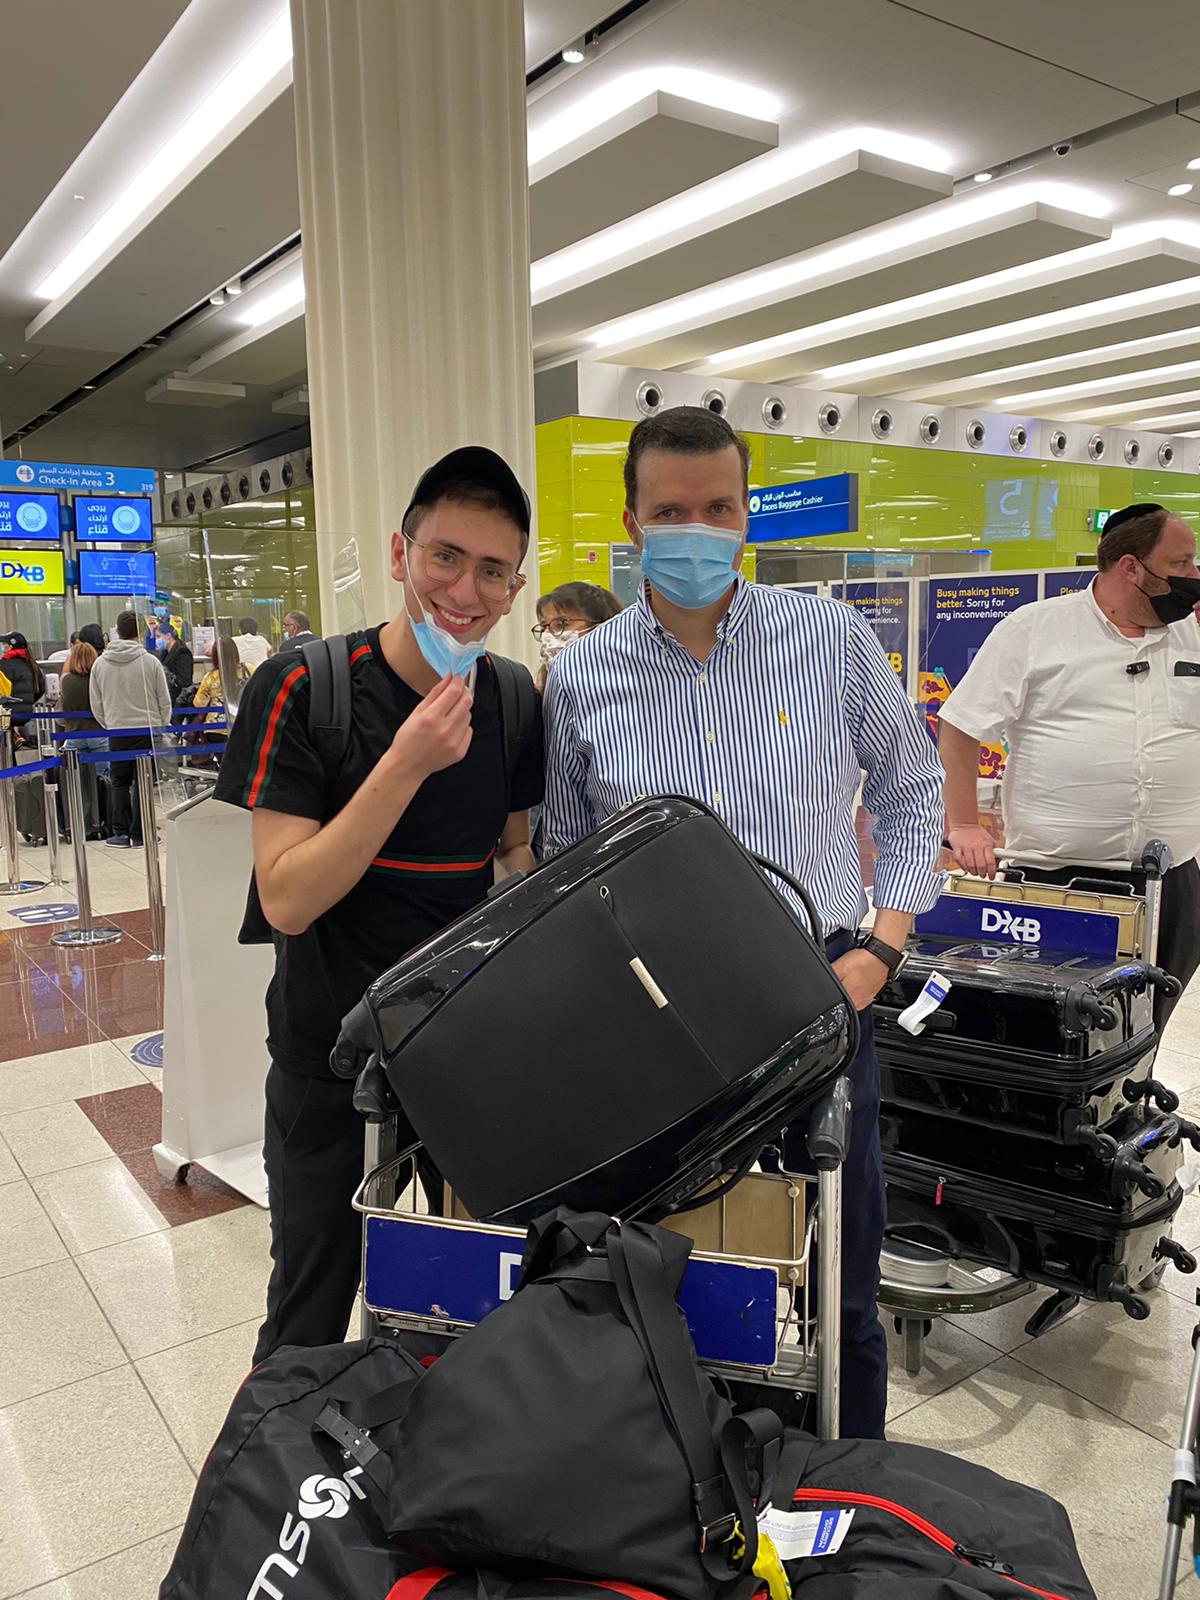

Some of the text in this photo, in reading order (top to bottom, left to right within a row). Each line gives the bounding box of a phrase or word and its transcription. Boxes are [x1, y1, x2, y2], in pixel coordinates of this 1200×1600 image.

[38, 475, 102, 487] Check-In Area
[105, 472, 115, 486] 3
[140, 483, 154, 491] 319
[762, 495, 824, 511] Excess Baggage Cashier
[1, 562, 45, 582] DXB
[936, 586, 1020, 599] Busy making things
[855, 597, 881, 606] making
[881, 596, 904, 606] things
[936, 598, 1006, 609] better. Sorry for
[861, 606, 893, 616] Sorry for
[936, 611, 951, 621] any
[981, 907, 1041, 943] DXB
